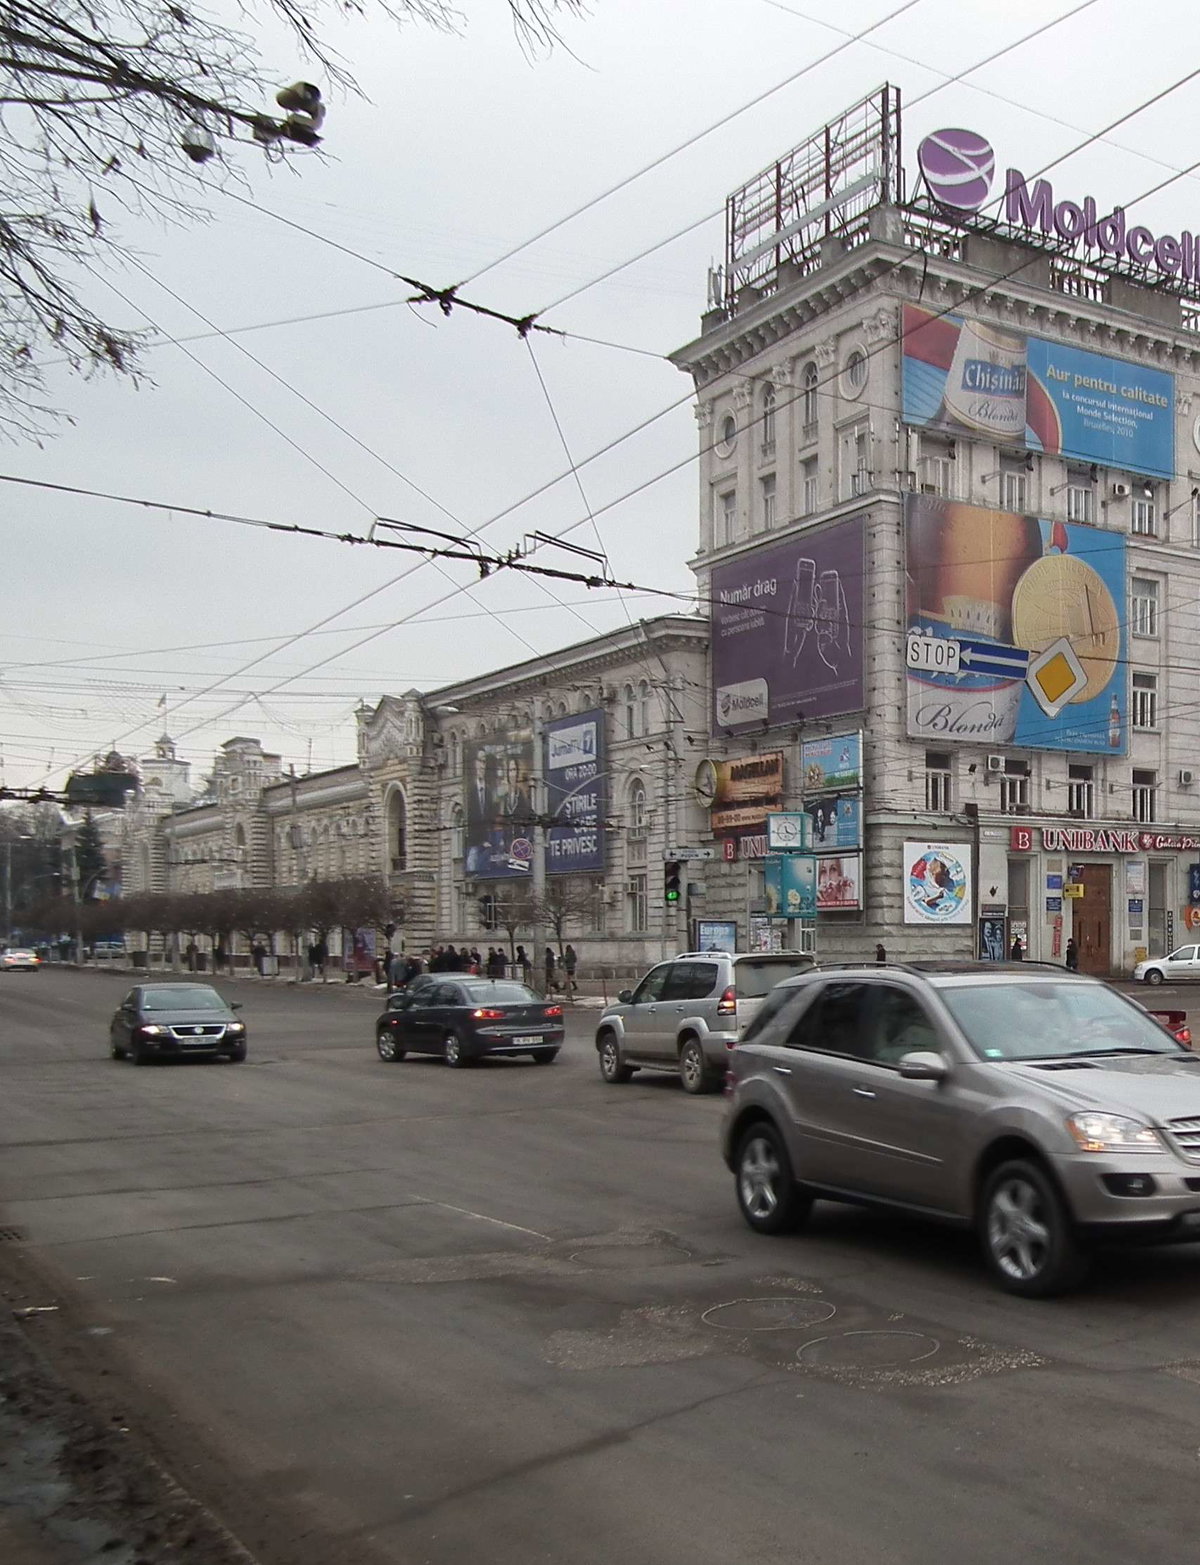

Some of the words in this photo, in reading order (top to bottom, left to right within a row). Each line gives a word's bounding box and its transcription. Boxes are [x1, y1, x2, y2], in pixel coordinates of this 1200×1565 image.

[1046, 365, 1070, 382] Aur
[1074, 374, 1117, 394] pentru
[1120, 386, 1169, 408] calitate
[1076, 405, 1102, 418] Monde
[1103, 413, 1138, 429] Selection,
[1116, 426, 1134, 438] 2010
[753, 578, 777, 597] drag
[911, 642, 956, 671] STOP
[550, 841, 561, 856] TE
[561, 836, 598, 855] PRIVESC
[1043, 828, 1138, 851] UNIBANK
